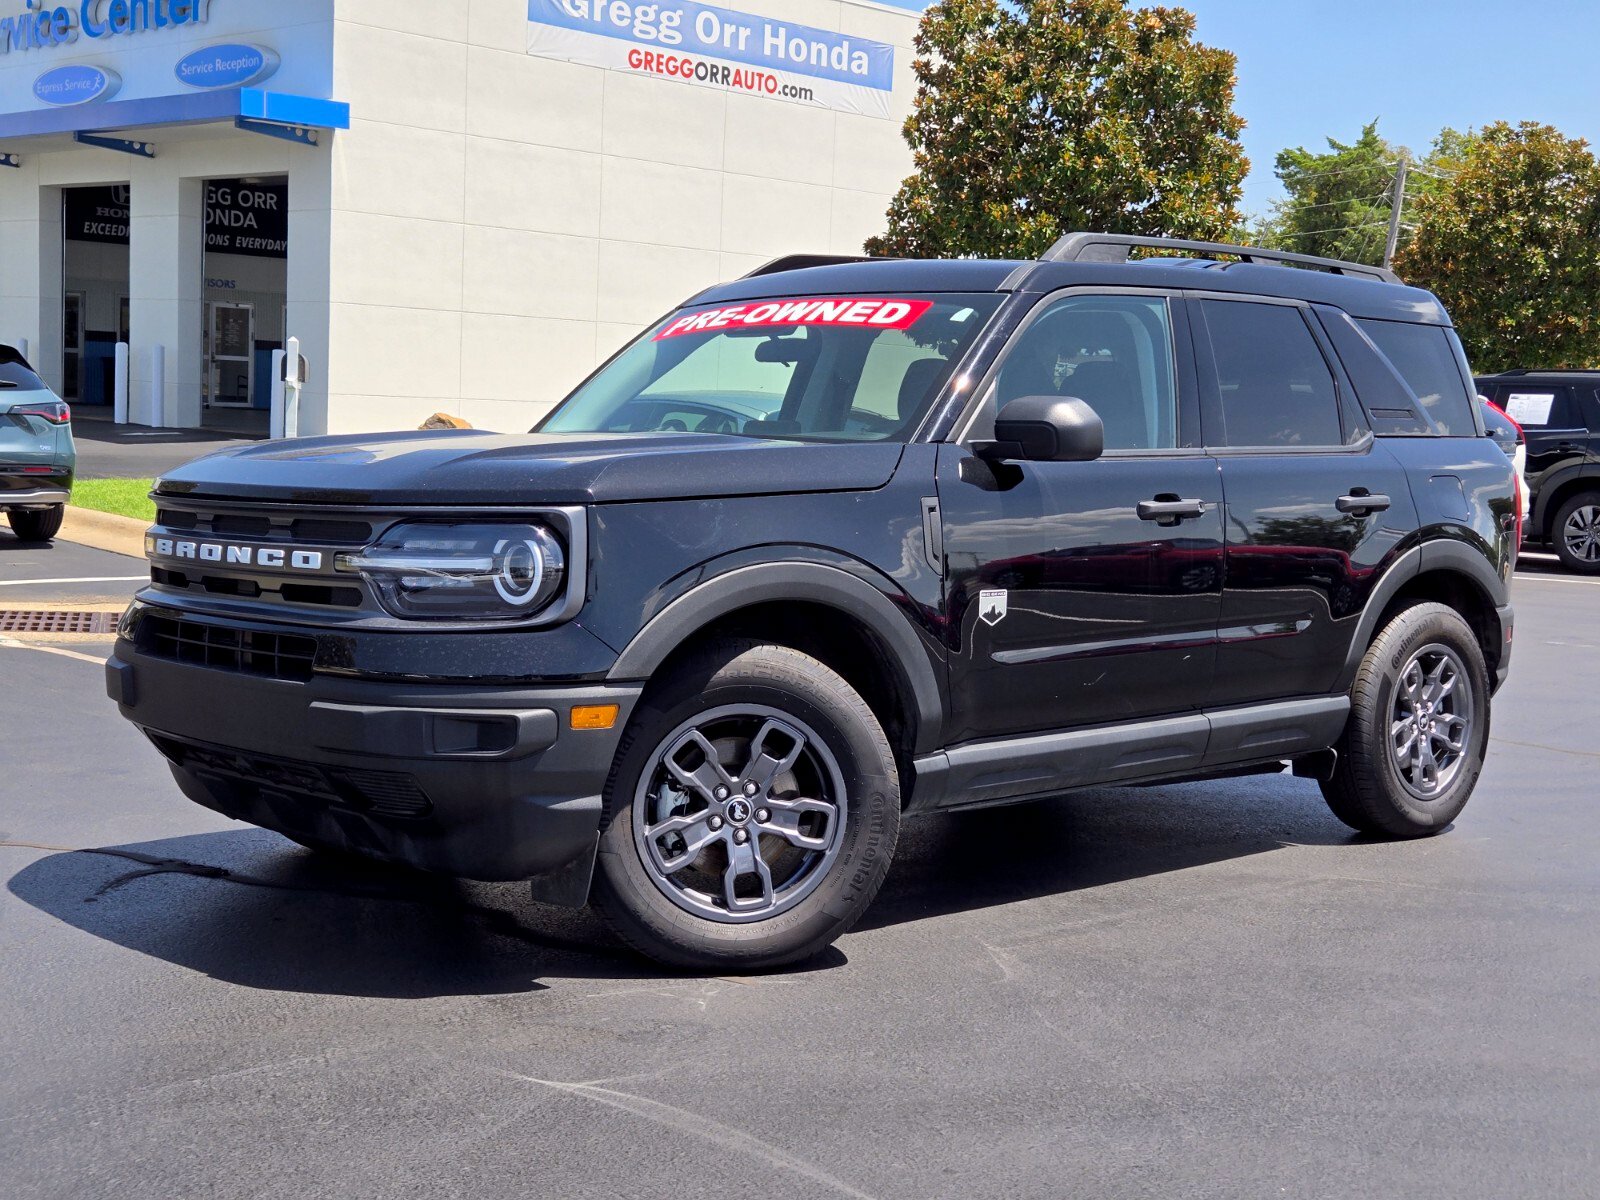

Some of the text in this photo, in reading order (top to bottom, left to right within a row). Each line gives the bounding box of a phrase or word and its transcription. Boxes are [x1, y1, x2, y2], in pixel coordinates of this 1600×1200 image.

[81, 0, 200, 38] Center
[561, 0, 869, 75] Gregg Orr Honda
[181, 54, 259, 76] Service Reception
[628, 48, 813, 101] GREGGORRAUTO.com
[37, 79, 91, 96] Express Service
[238, 190, 277, 210] ORR
[235, 236, 287, 251] EVERYDAY
[204, 278, 236, 289] ISORS
[662, 300, 911, 337] PRE-OWNED
[156, 538, 322, 570] BRONCO
